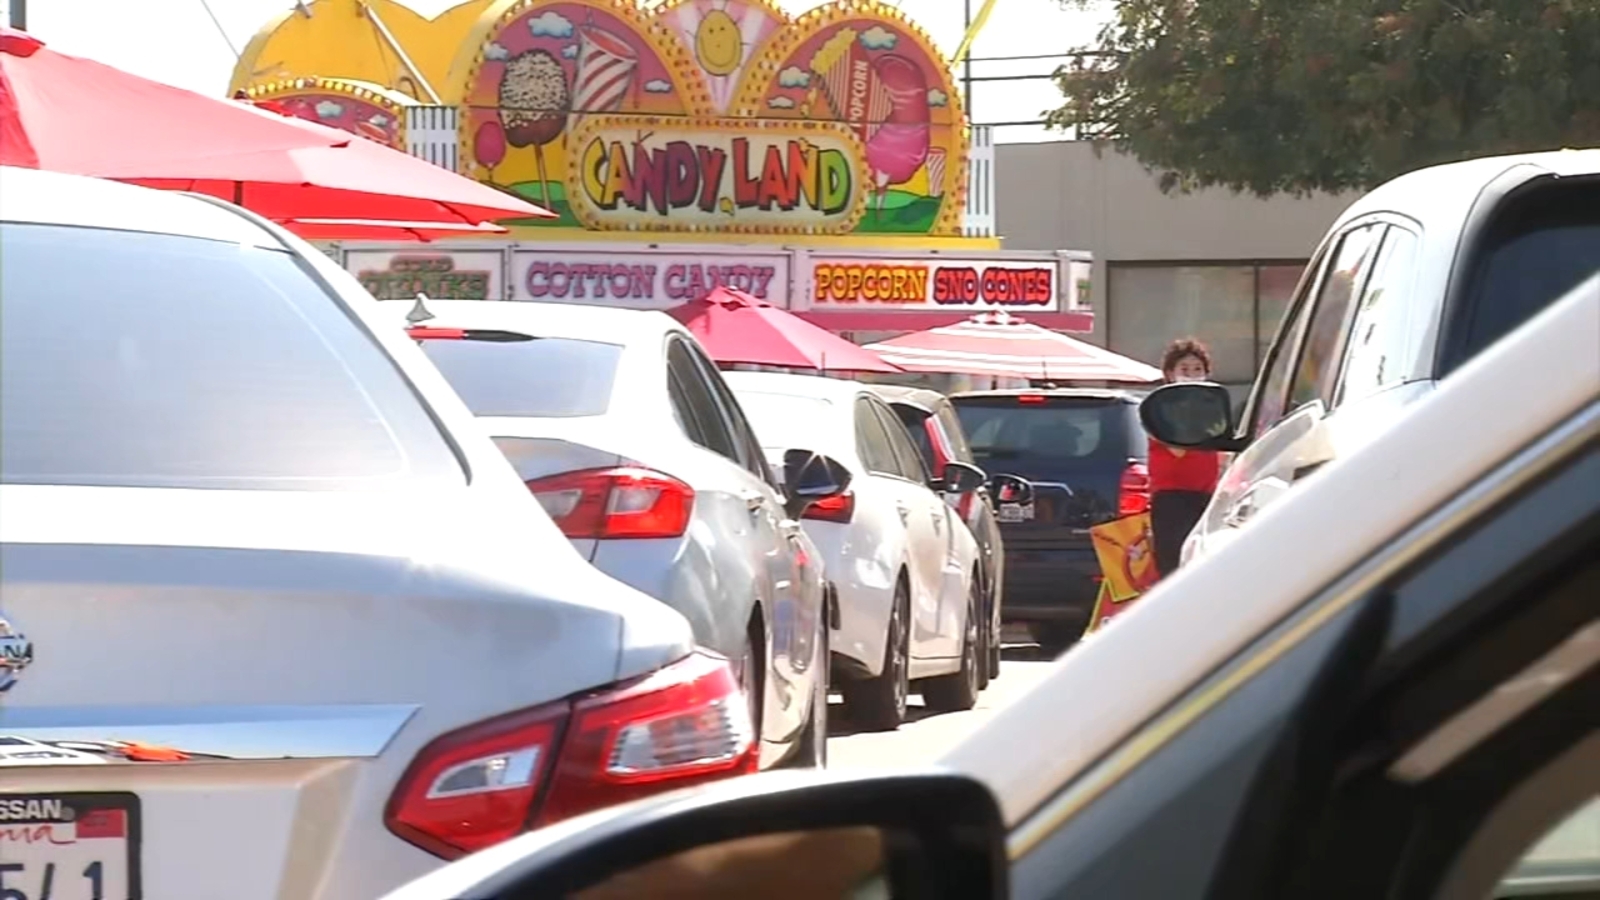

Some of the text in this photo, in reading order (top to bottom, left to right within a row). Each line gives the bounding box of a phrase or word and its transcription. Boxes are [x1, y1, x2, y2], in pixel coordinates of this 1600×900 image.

[848, 60, 869, 127] POPCORN
[581, 135, 851, 215] CANDY LAND
[526, 261, 775, 299] COTTON CANDY
[815, 264, 928, 303] POPCORN
[933, 266, 978, 304] SNO
[981, 267, 1053, 305] CONES
